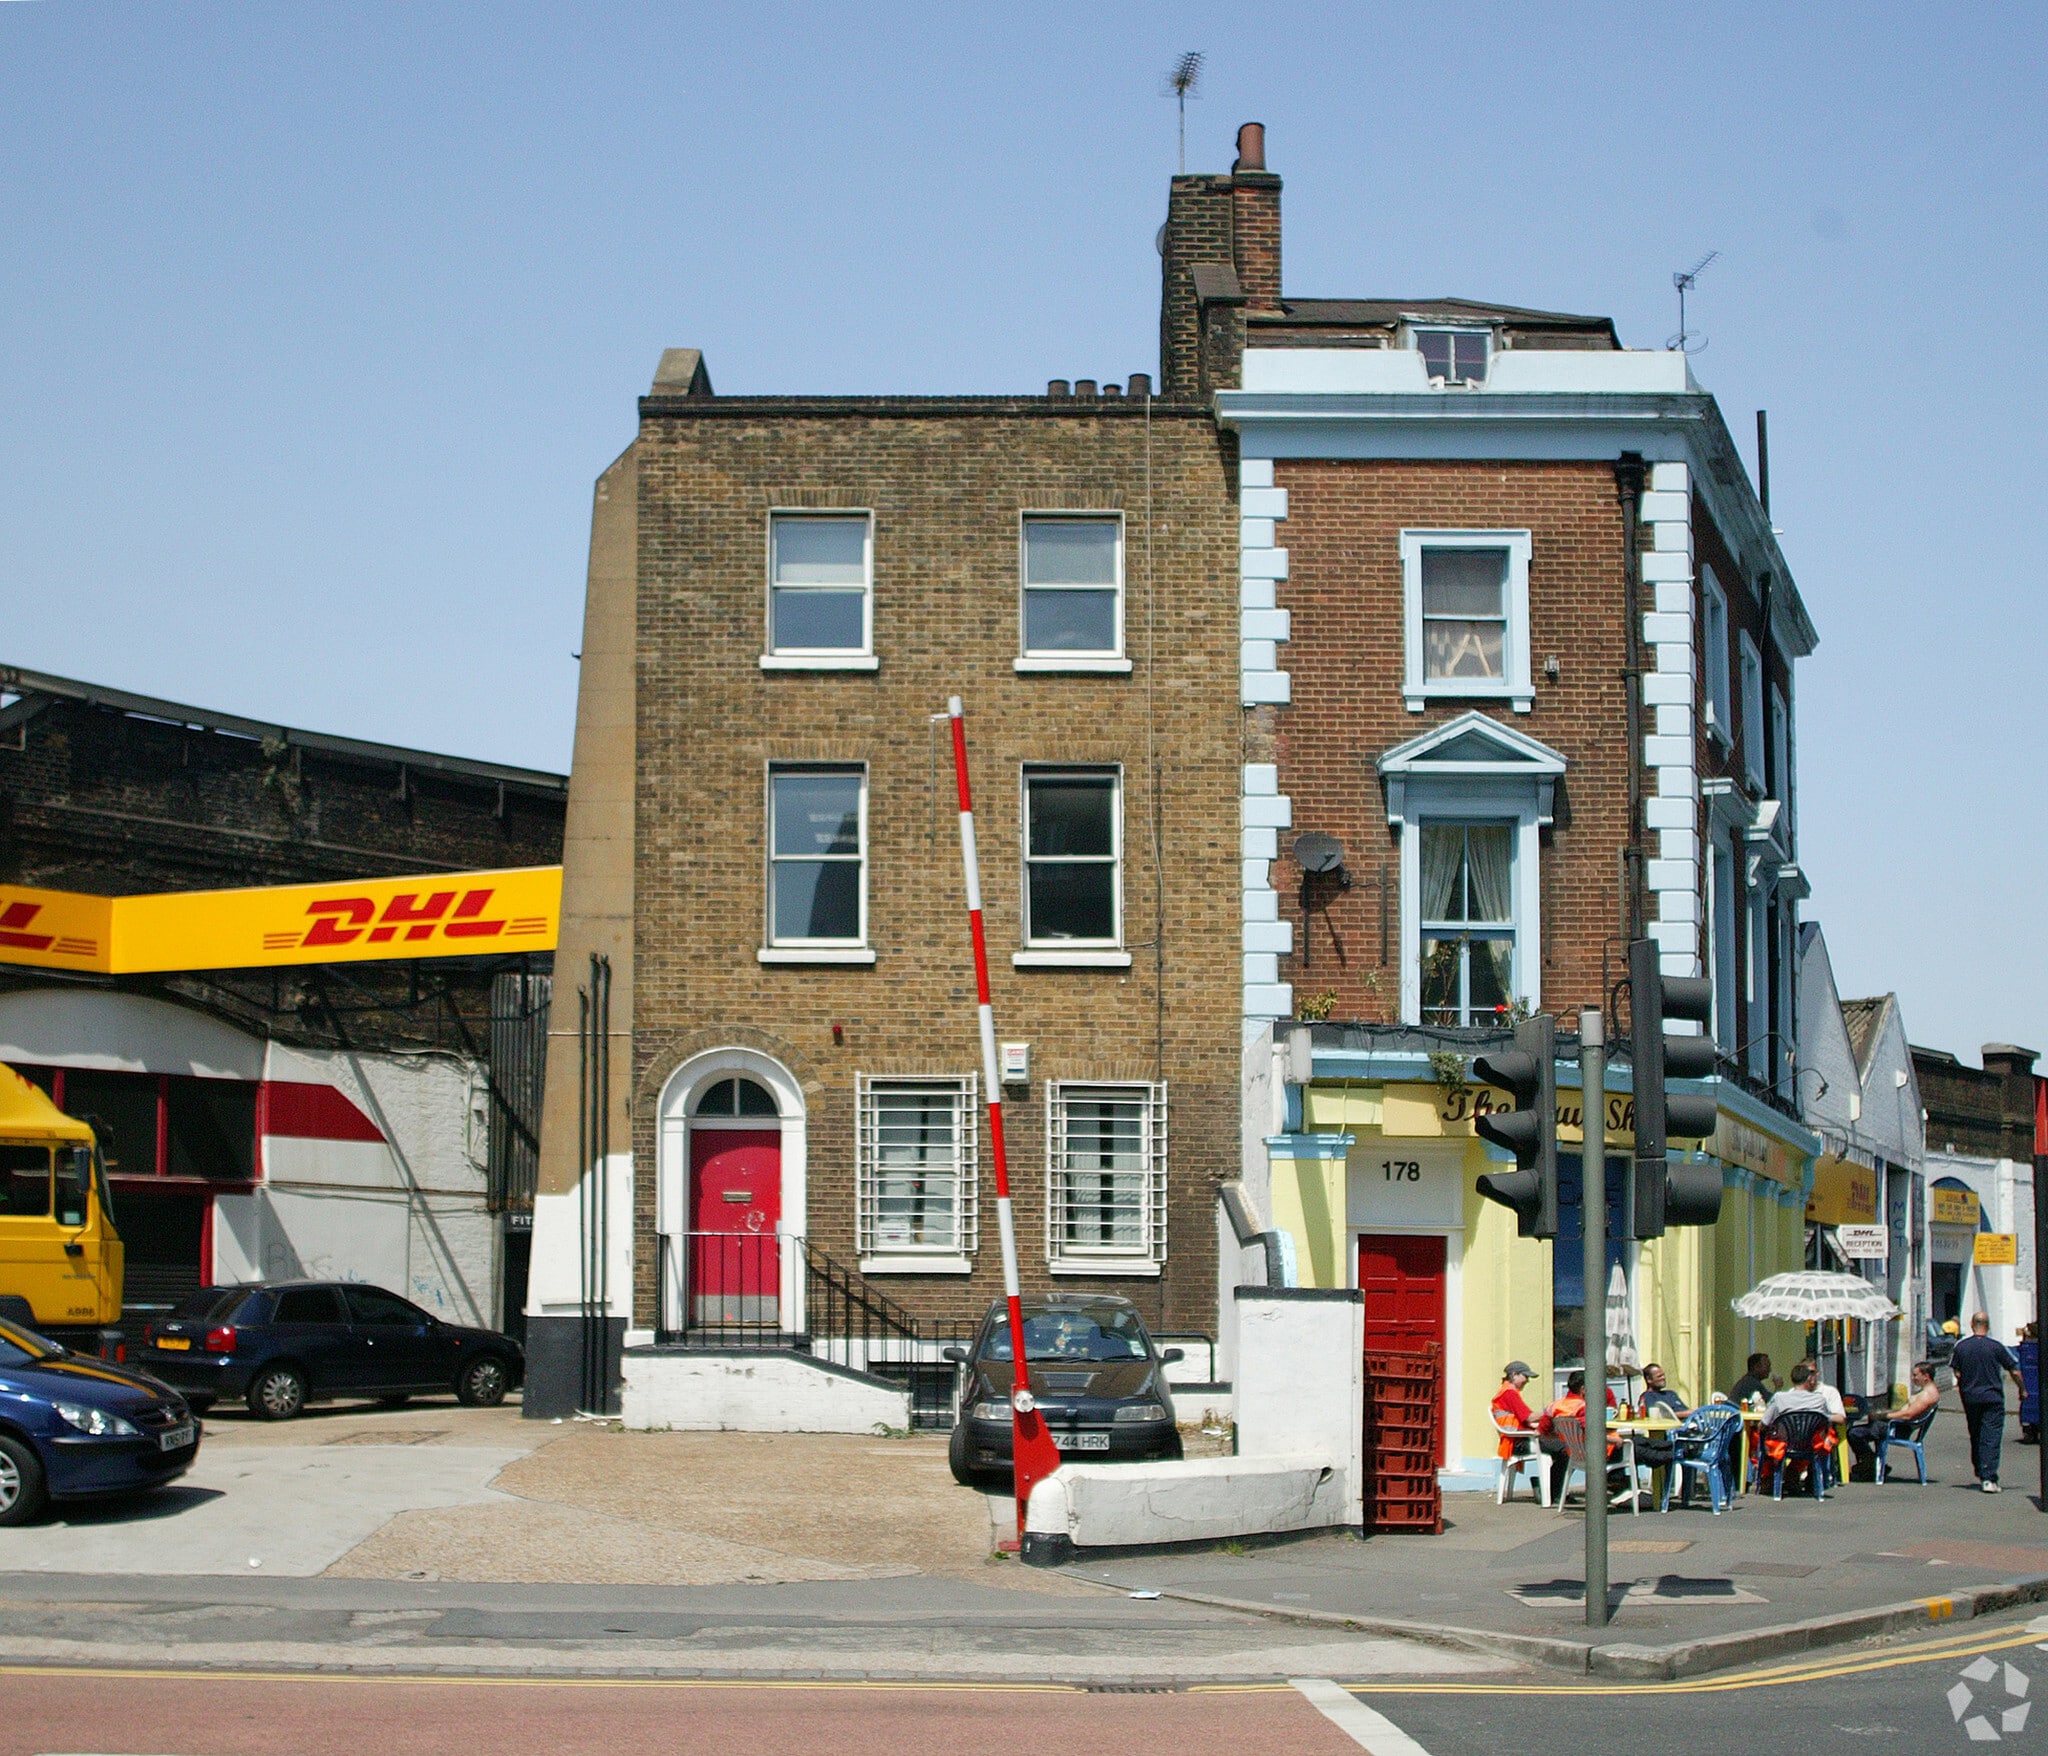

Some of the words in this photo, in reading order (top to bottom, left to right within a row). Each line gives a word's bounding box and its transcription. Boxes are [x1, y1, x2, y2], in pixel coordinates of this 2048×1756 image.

[301, 889, 507, 948] DHL
[1442, 1089, 1511, 1122] The
[1606, 1099, 1635, 1131] Sh
[1382, 1161, 1420, 1181] 178
[1846, 1240, 1883, 1248] RECEPTION
[1052, 1435, 1078, 1448] 744
[1082, 1435, 1108, 1448] HRK
